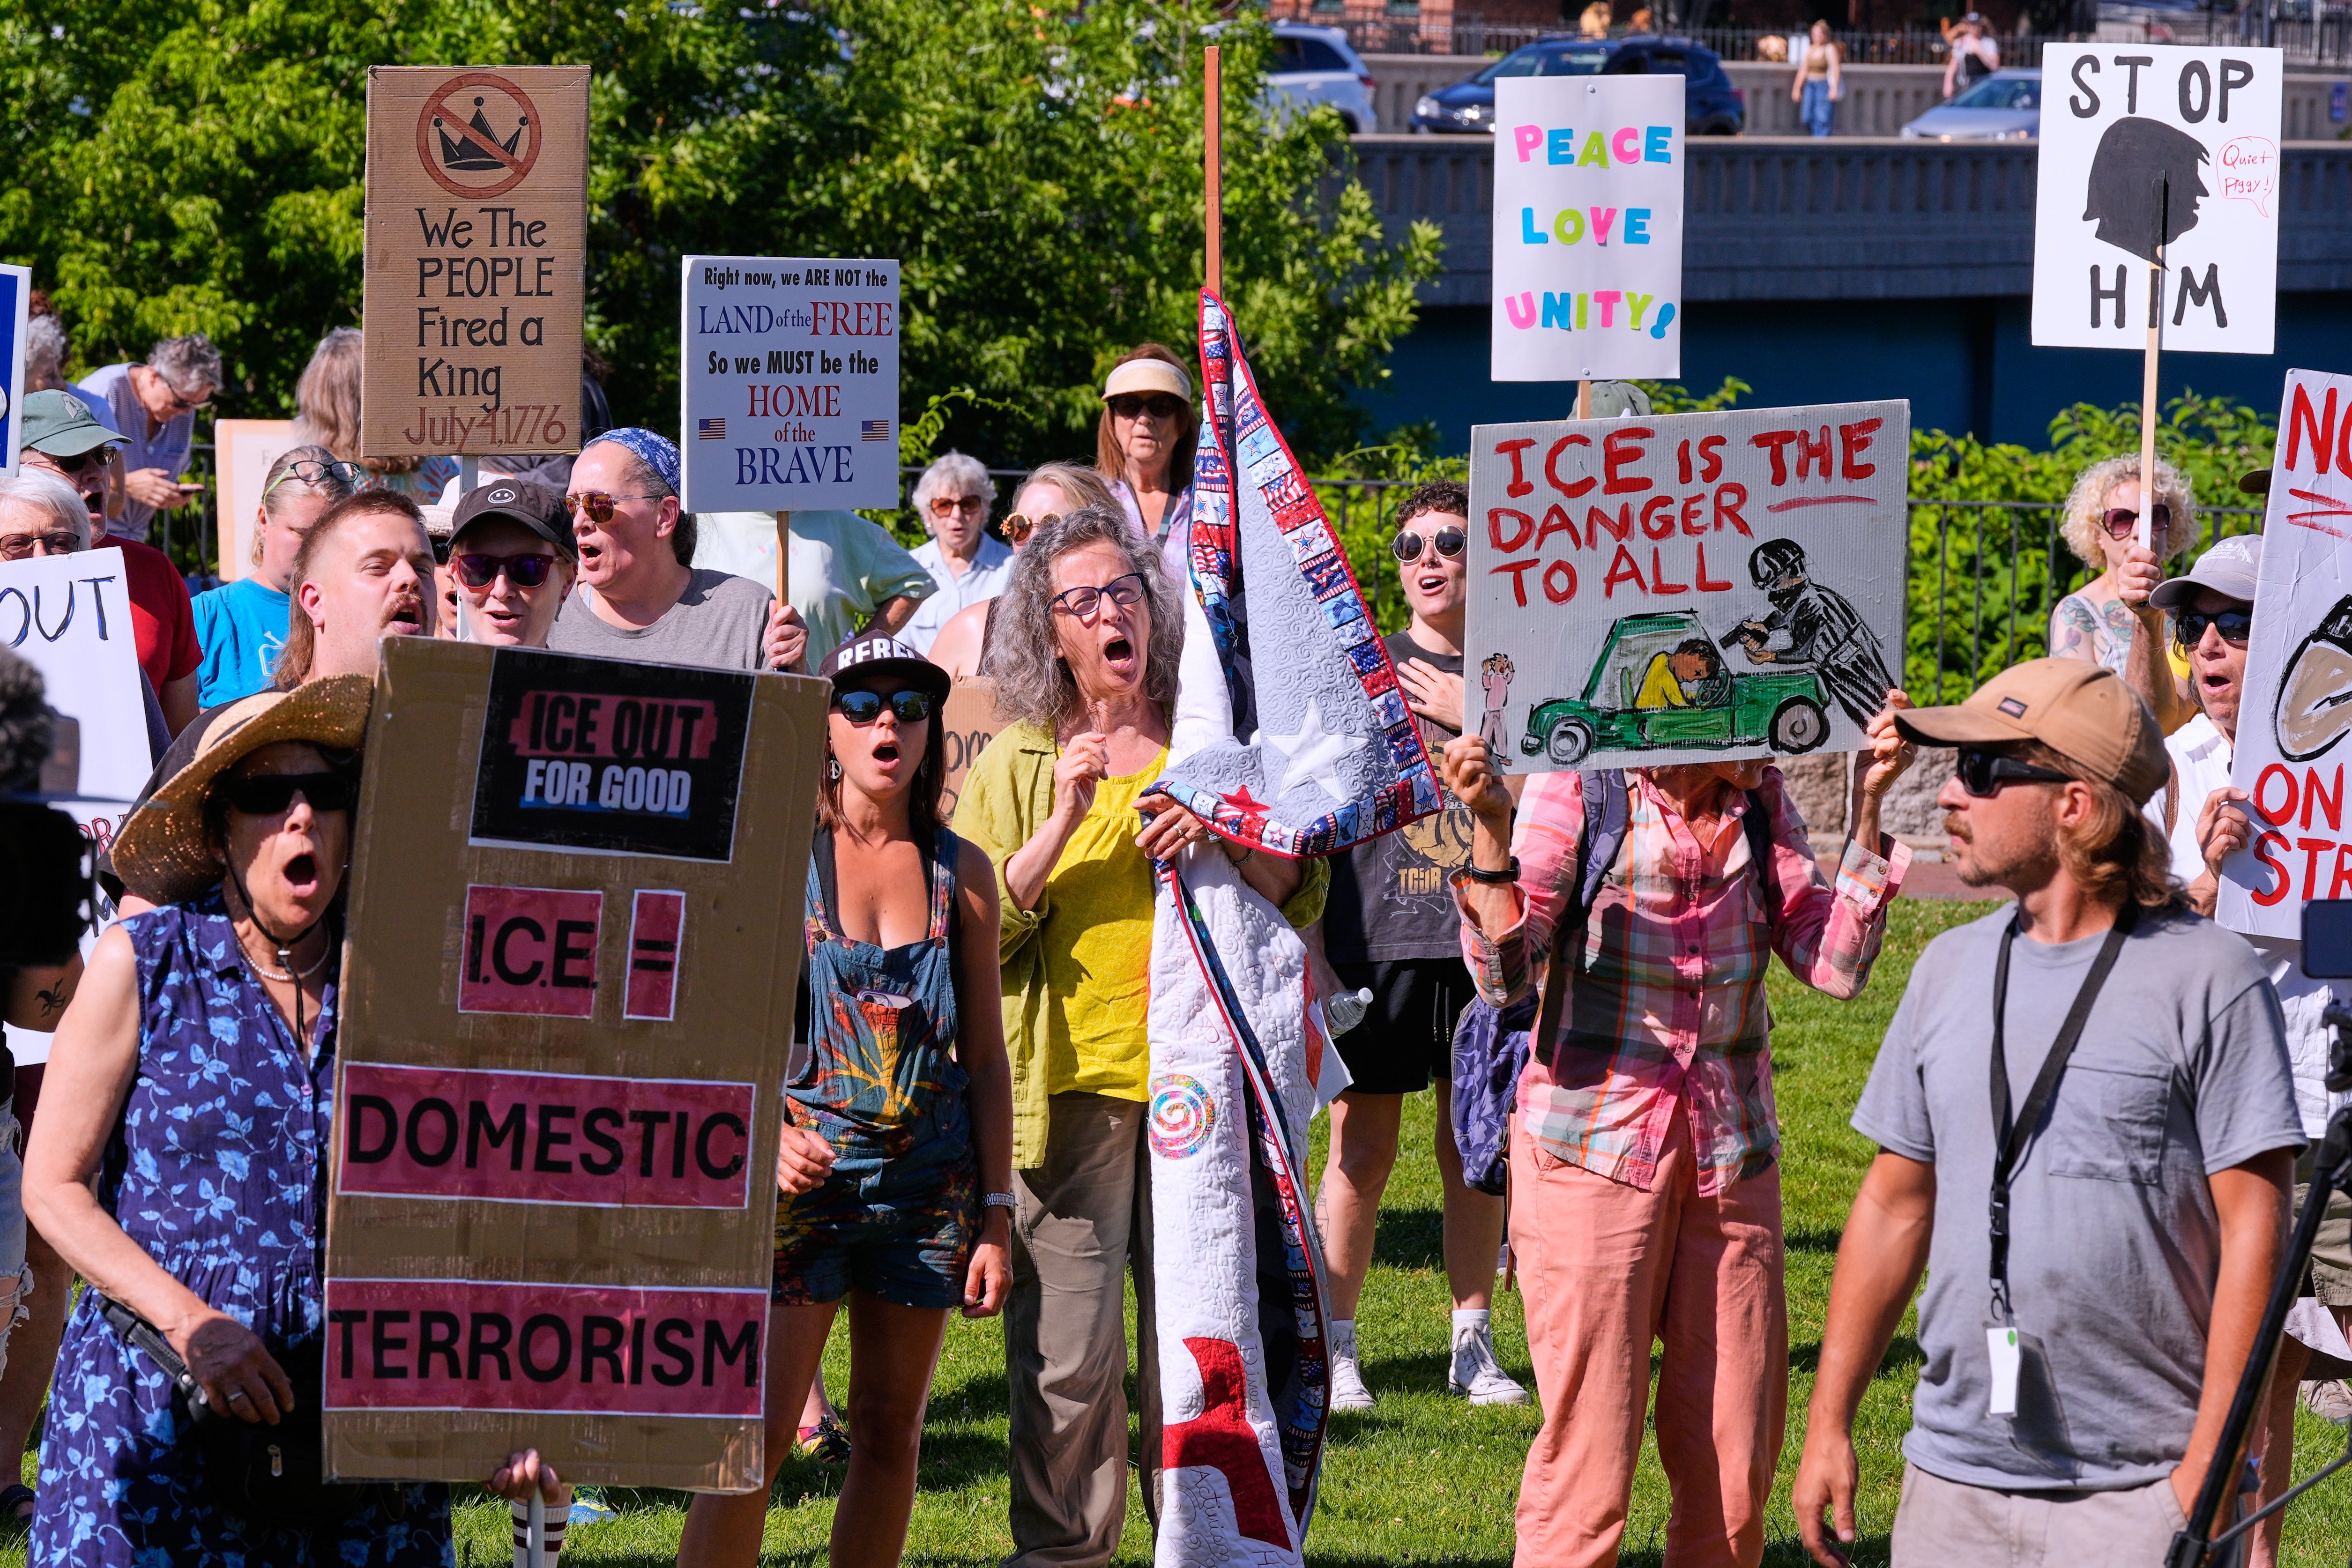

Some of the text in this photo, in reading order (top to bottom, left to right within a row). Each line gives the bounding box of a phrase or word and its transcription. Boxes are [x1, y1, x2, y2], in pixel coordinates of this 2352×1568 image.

[2069, 54, 2254, 123] STOP
[1514, 125, 1672, 168] PEACE
[2223, 145, 2274, 169] Quiet
[415, 208, 546, 248] We The
[1522, 207, 1651, 245] LOVE
[417, 256, 555, 297] PEOPLE
[705, 267, 887, 290] Right now, we ARE NOT the
[2090, 263, 2227, 328] HIM
[417, 306, 543, 347] Fired a
[698, 302, 893, 336] LAND of the FREE
[1504, 291, 1675, 339] UNITY!
[708, 349, 878, 374] So we MUST be the
[417, 357, 501, 413] King
[747, 385, 841, 417] HOME
[402, 406, 476, 452] July
[774, 422, 815, 442] of the
[735, 446, 853, 485] BRAVE
[1495, 417, 1883, 498] ICE IS THE
[1488, 483, 1754, 553] DANGER
[1489, 542, 1733, 608] TO ALL
[528, 695, 704, 763] ICE OUT
[525, 759, 692, 813] FOR GOOD
[2254, 763, 2344, 832] ON
[1399, 867, 1442, 895] TOUR
[347, 1094, 746, 1180] DOMESTIC
[328, 1309, 759, 1388] TERRORISM
